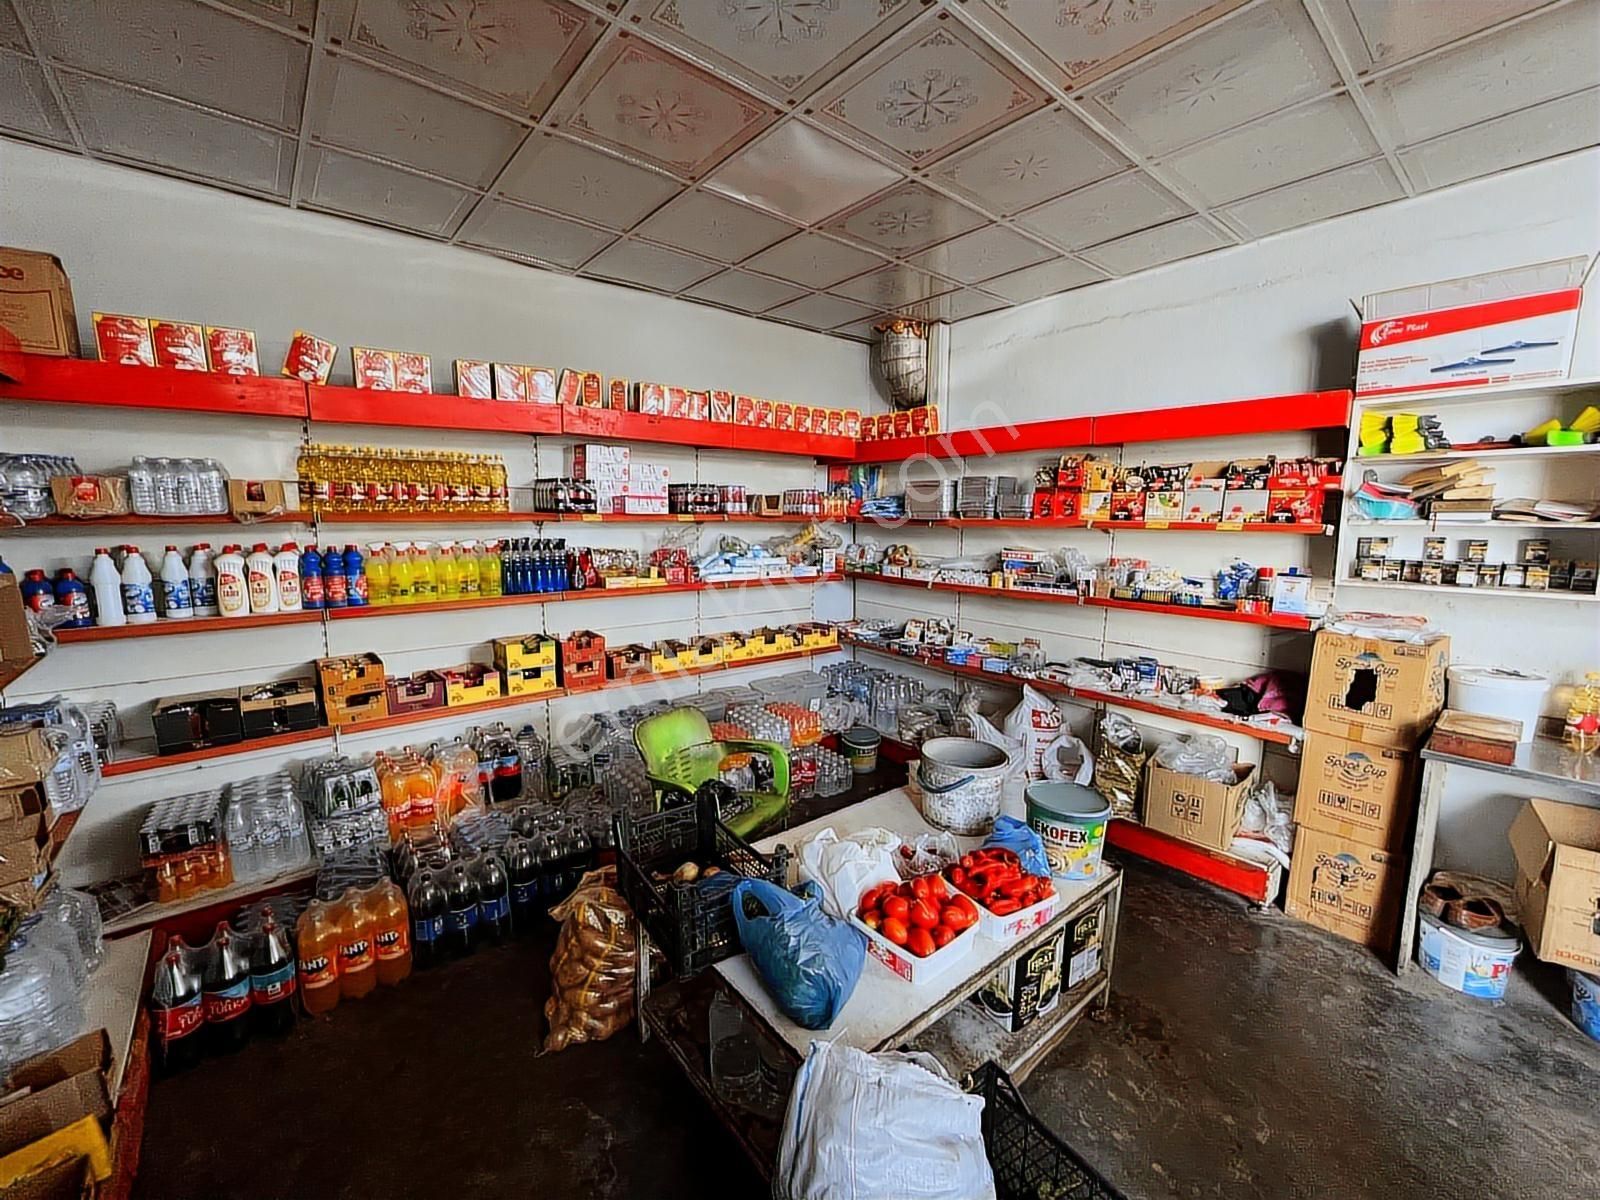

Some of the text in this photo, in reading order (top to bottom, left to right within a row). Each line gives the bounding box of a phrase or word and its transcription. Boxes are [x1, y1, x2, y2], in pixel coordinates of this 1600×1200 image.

[1374, 662, 1400, 678] Cup
[1324, 754, 1388, 779] Space Cup
[1034, 819, 1088, 843] EKOFEX
[1315, 853, 1377, 881] Space Cup
